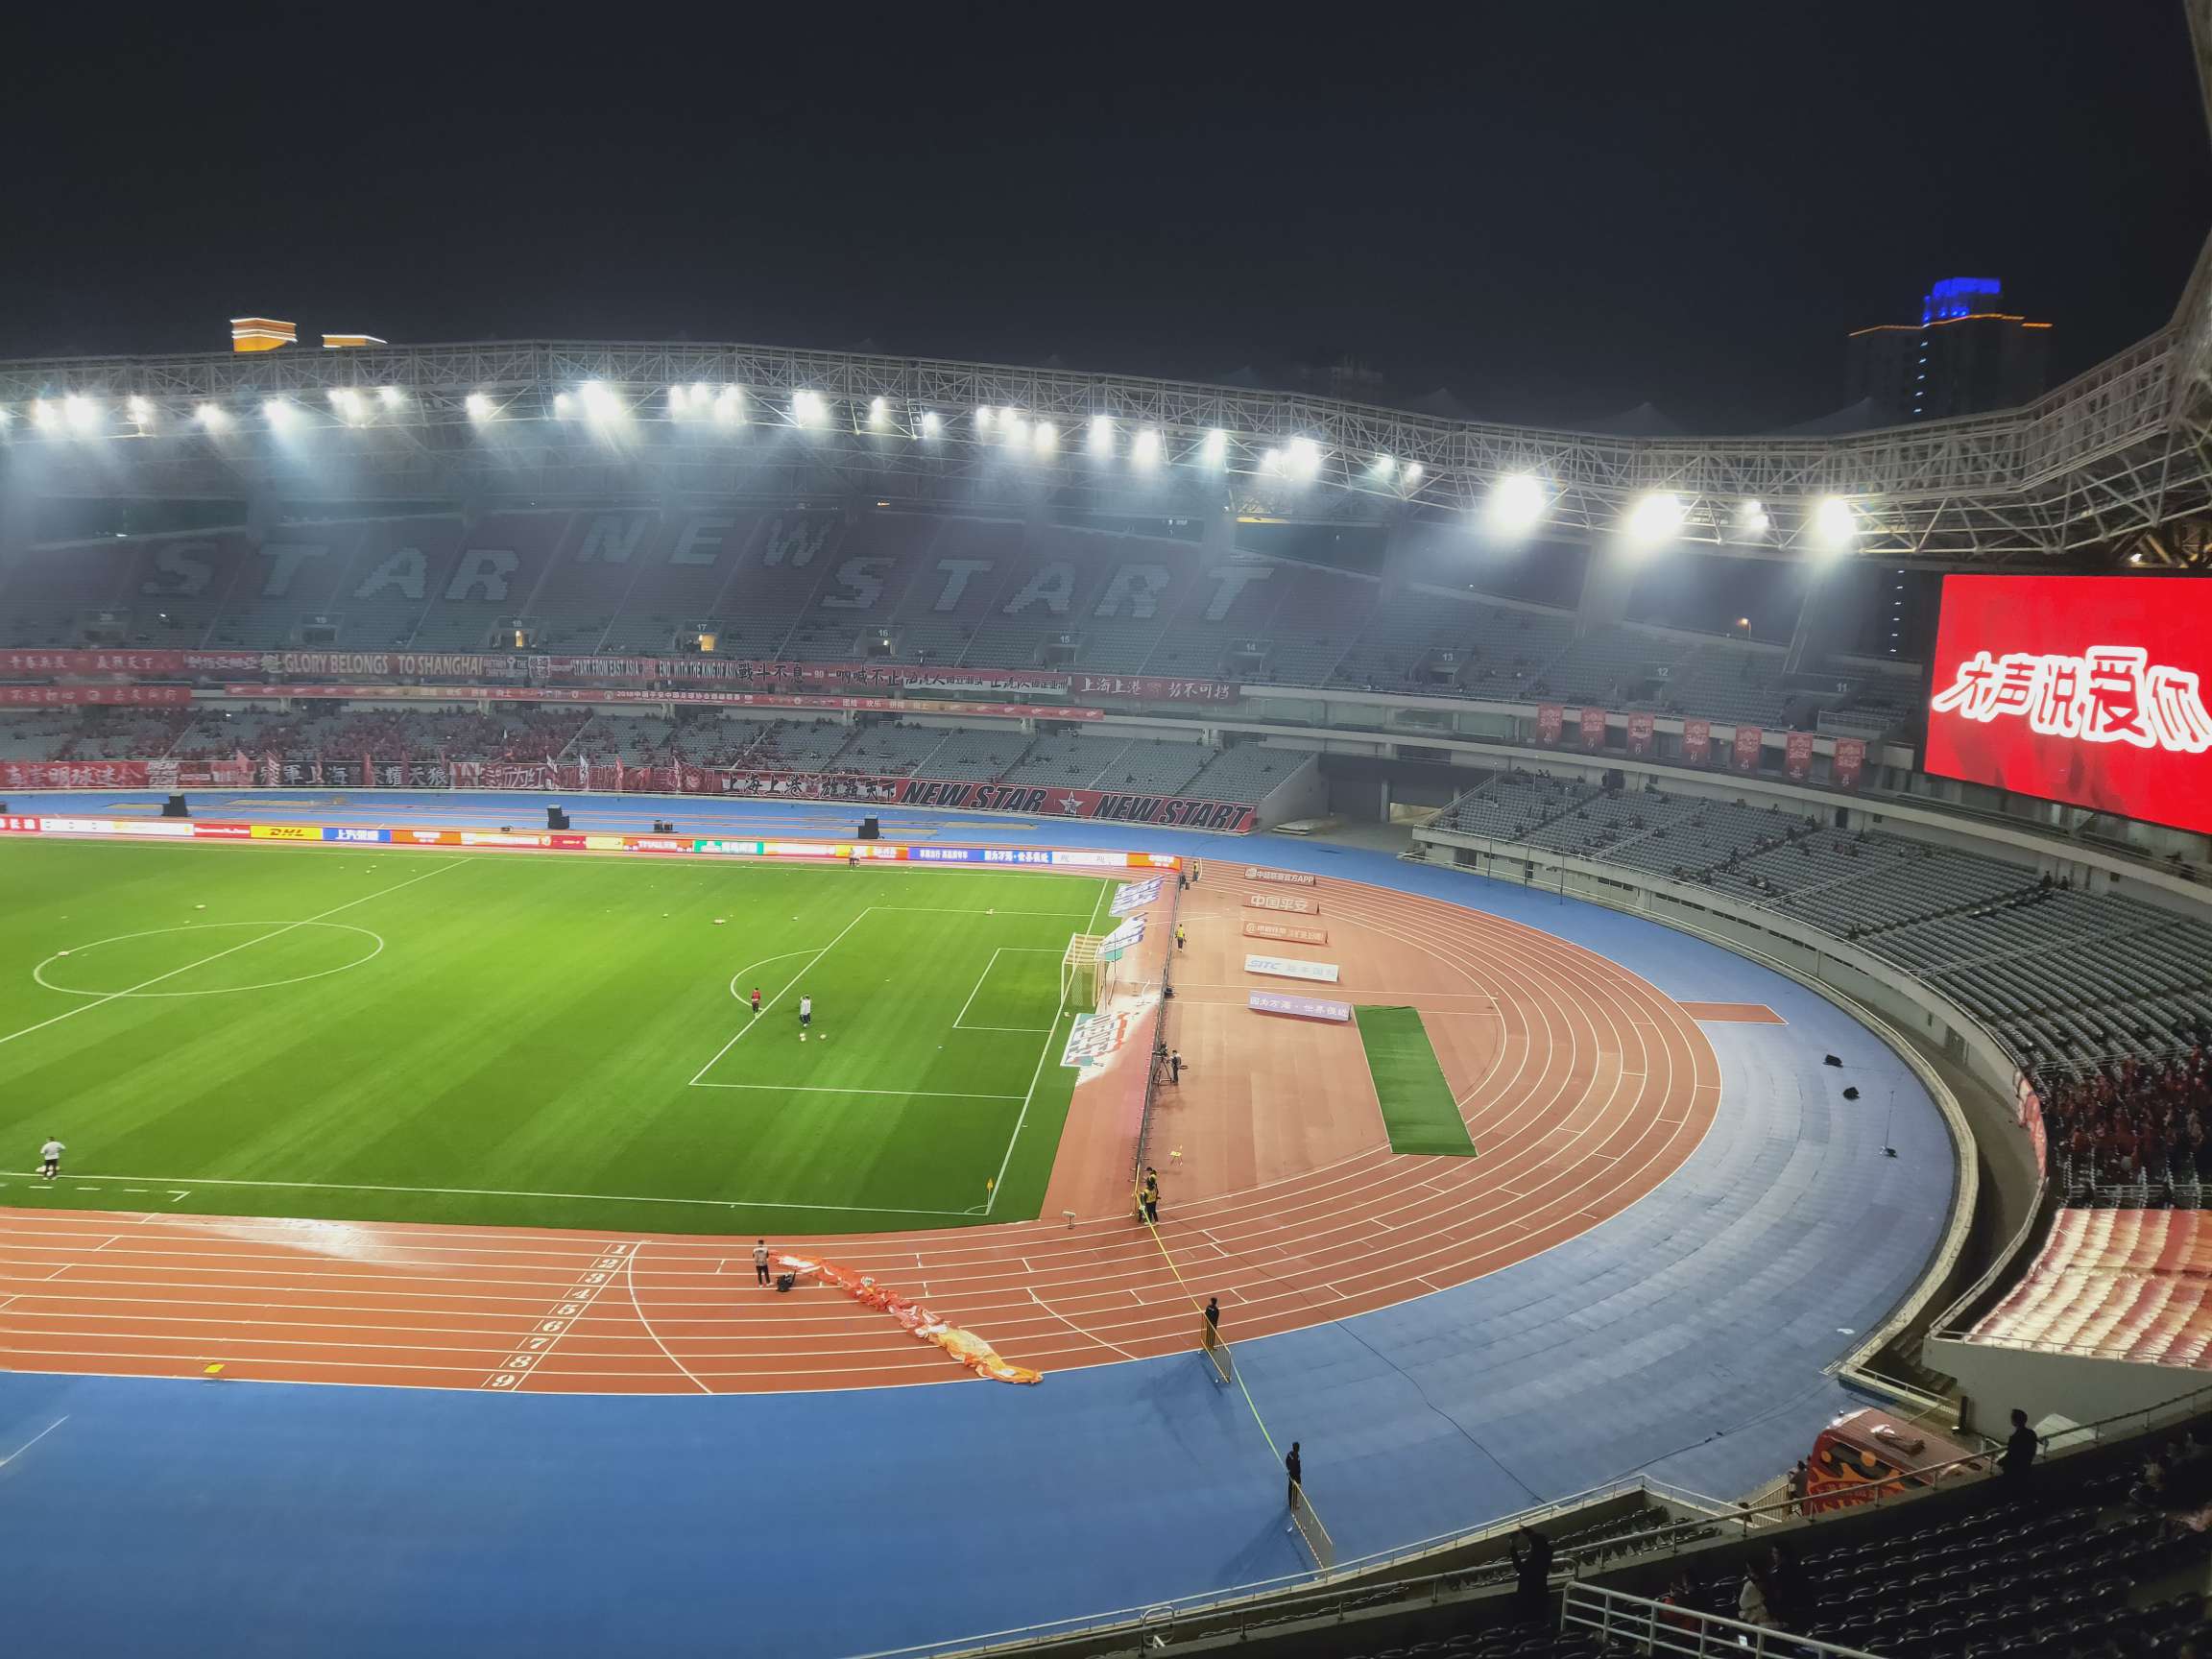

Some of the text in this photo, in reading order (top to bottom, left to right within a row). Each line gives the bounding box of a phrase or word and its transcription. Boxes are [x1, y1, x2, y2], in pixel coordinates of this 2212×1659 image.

[142, 541, 519, 601] STAR
[822, 557, 1273, 621] START
[1442, 653, 1454, 661] 13
[285, 654, 328, 673] GLORY
[330, 655, 388, 674] BELONGS
[397, 656, 415, 675] TO
[418, 656, 484, 676] SHANGHAI
[573, 660, 639, 677] START FROM EAST ASIA
[660, 661, 671, 677] END
[674, 661, 688, 678] WITH
[690, 661, 701, 679] THE
[702, 661, 716, 679] KING
[717, 662, 724, 679] OF
[1658, 667, 1670, 677] 12
[1080, 676, 1142, 696] 上海上港
[1837, 683, 1848, 692] 11
[725, 771, 803, 796] 上海上港
[900, 781, 974, 808] NEW
[971, 784, 1049, 814] STAR
[1090, 793, 1161, 824] NEW
[1159, 798, 1254, 832] START
[270, 828, 304, 837] DHL
[1251, 894, 1307, 911] 中国平安
[1248, 959, 1282, 971] SITC
[612, 1244, 627, 1255] 1
[598, 1259, 618, 1269] 2
[585, 1273, 606, 1284] 3
[572, 1288, 590, 1299] 4
[557, 1304, 580, 1315] 5
[542, 1320, 565, 1333] 6
[529, 1337, 549, 1349] 7
[509, 1356, 532, 1368] 8
[492, 1374, 516, 1387] 9
